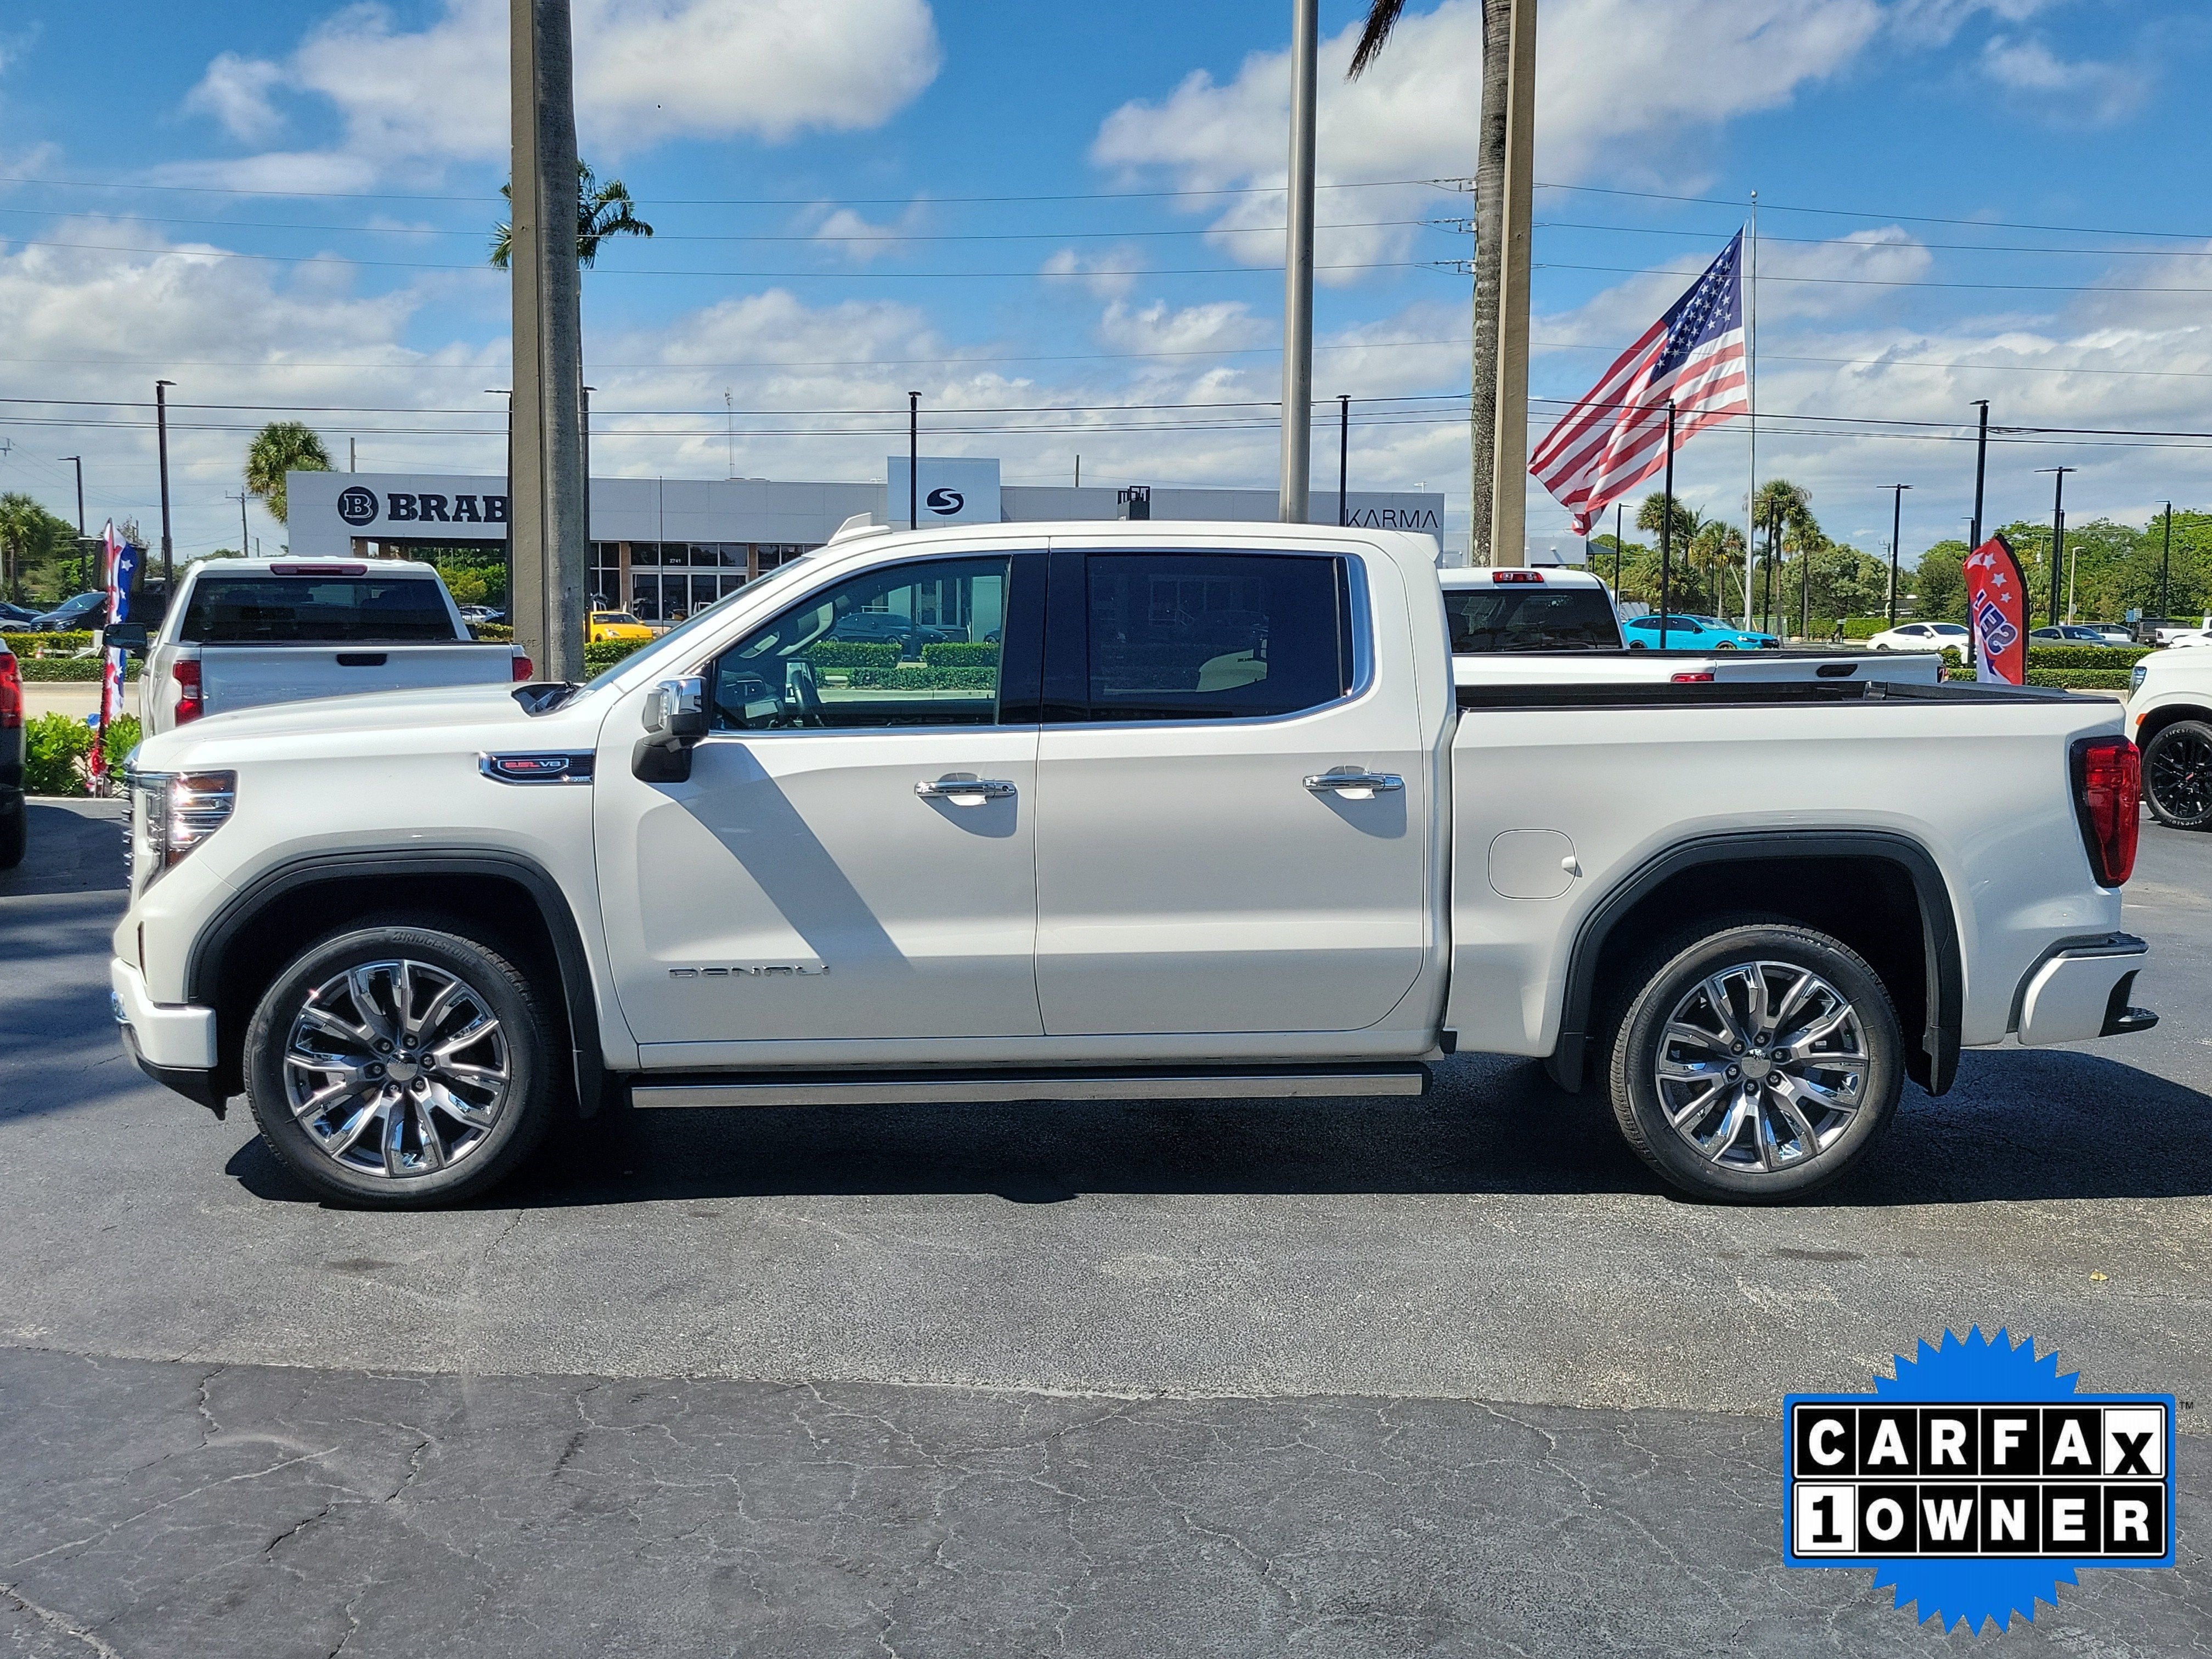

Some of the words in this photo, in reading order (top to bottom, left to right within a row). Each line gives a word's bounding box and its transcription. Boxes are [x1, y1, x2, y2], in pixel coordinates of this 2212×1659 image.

[1346, 509, 1438, 528] KARMA
[392, 932, 476, 964] BRIDGESTONE
[669, 966, 830, 978] DENALI
